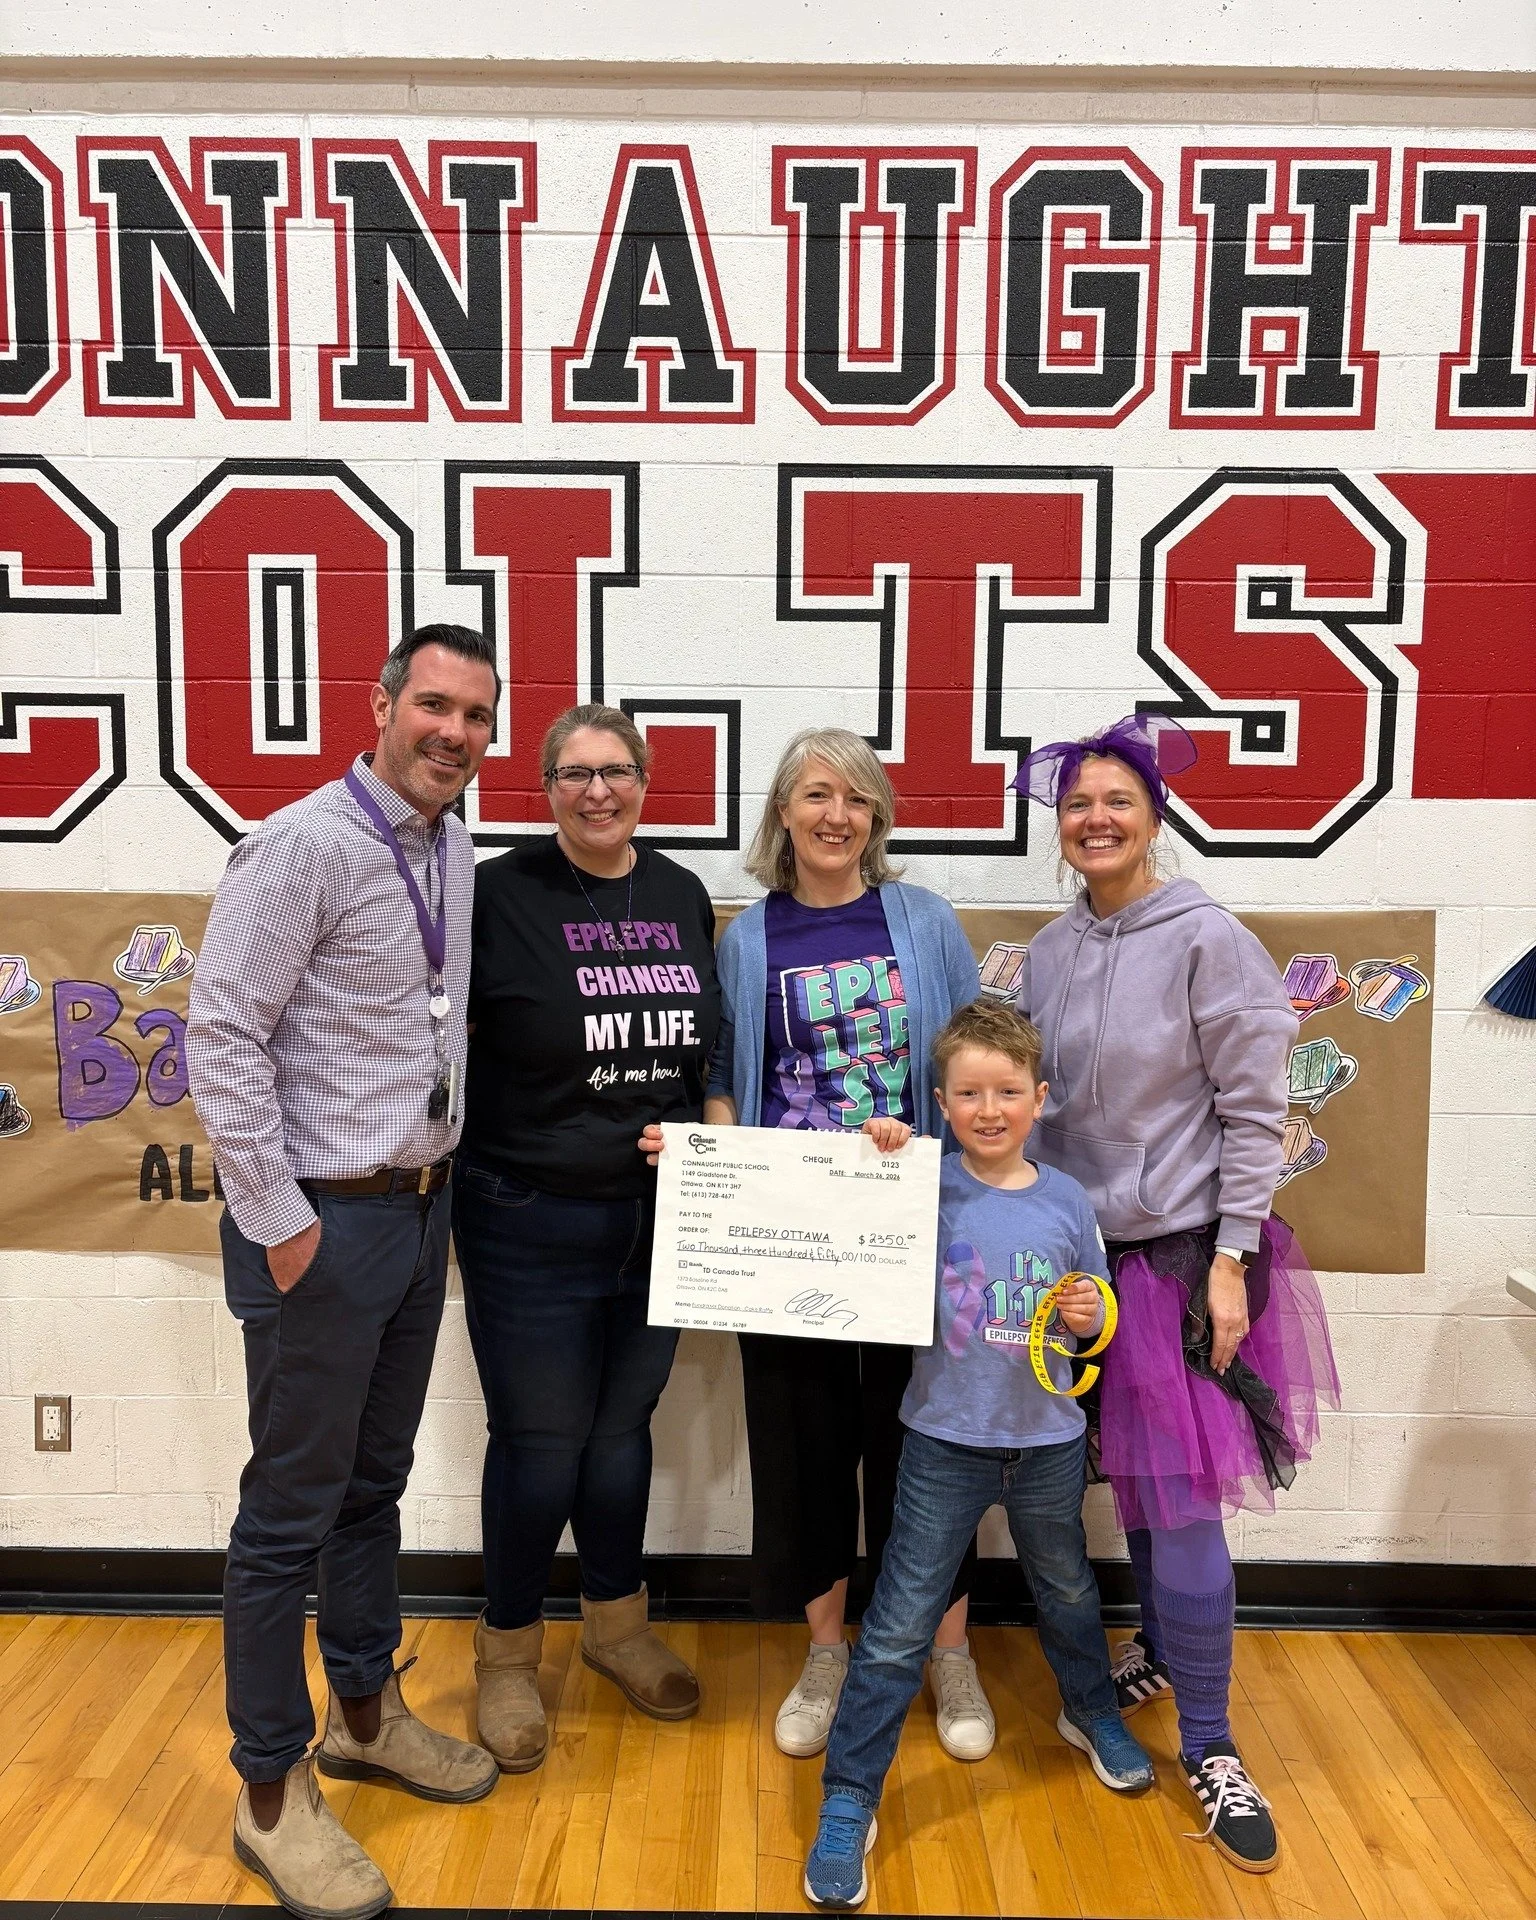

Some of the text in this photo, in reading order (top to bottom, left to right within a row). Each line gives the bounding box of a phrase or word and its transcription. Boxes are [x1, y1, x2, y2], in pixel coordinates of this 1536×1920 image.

[562, 921, 682, 952] EPILEPSY
[576, 965, 701, 997] CHANGED
[795, 955, 893, 1023] EPI
[584, 1010, 701, 1051] MY LIFE.
[587, 1063, 618, 1091] Ask
[624, 1069, 647, 1083] me
[828, 1049, 911, 1126] SY
[682, 1160, 721, 1168] CONNAUGHT
[802, 1155, 833, 1164] CHEQUE
[881, 1160, 900, 1169] 0123
[691, 1191, 707, 1199] (613)
[728, 1225, 830, 1242] EPILEPSY OTTAWA
[858, 1234, 866, 1246] $
[677, 1240, 696, 1251] Two
[742, 1245, 767, 1256] three
[768, 1246, 807, 1259] Hundred
[841, 1251, 877, 1263] 00/100
[878, 1257, 907, 1266] DOLLARS
[1010, 1250, 1054, 1287] I'M
[983, 1279, 1007, 1325] 1
[989, 1330, 1027, 1343] EPILEPSY
